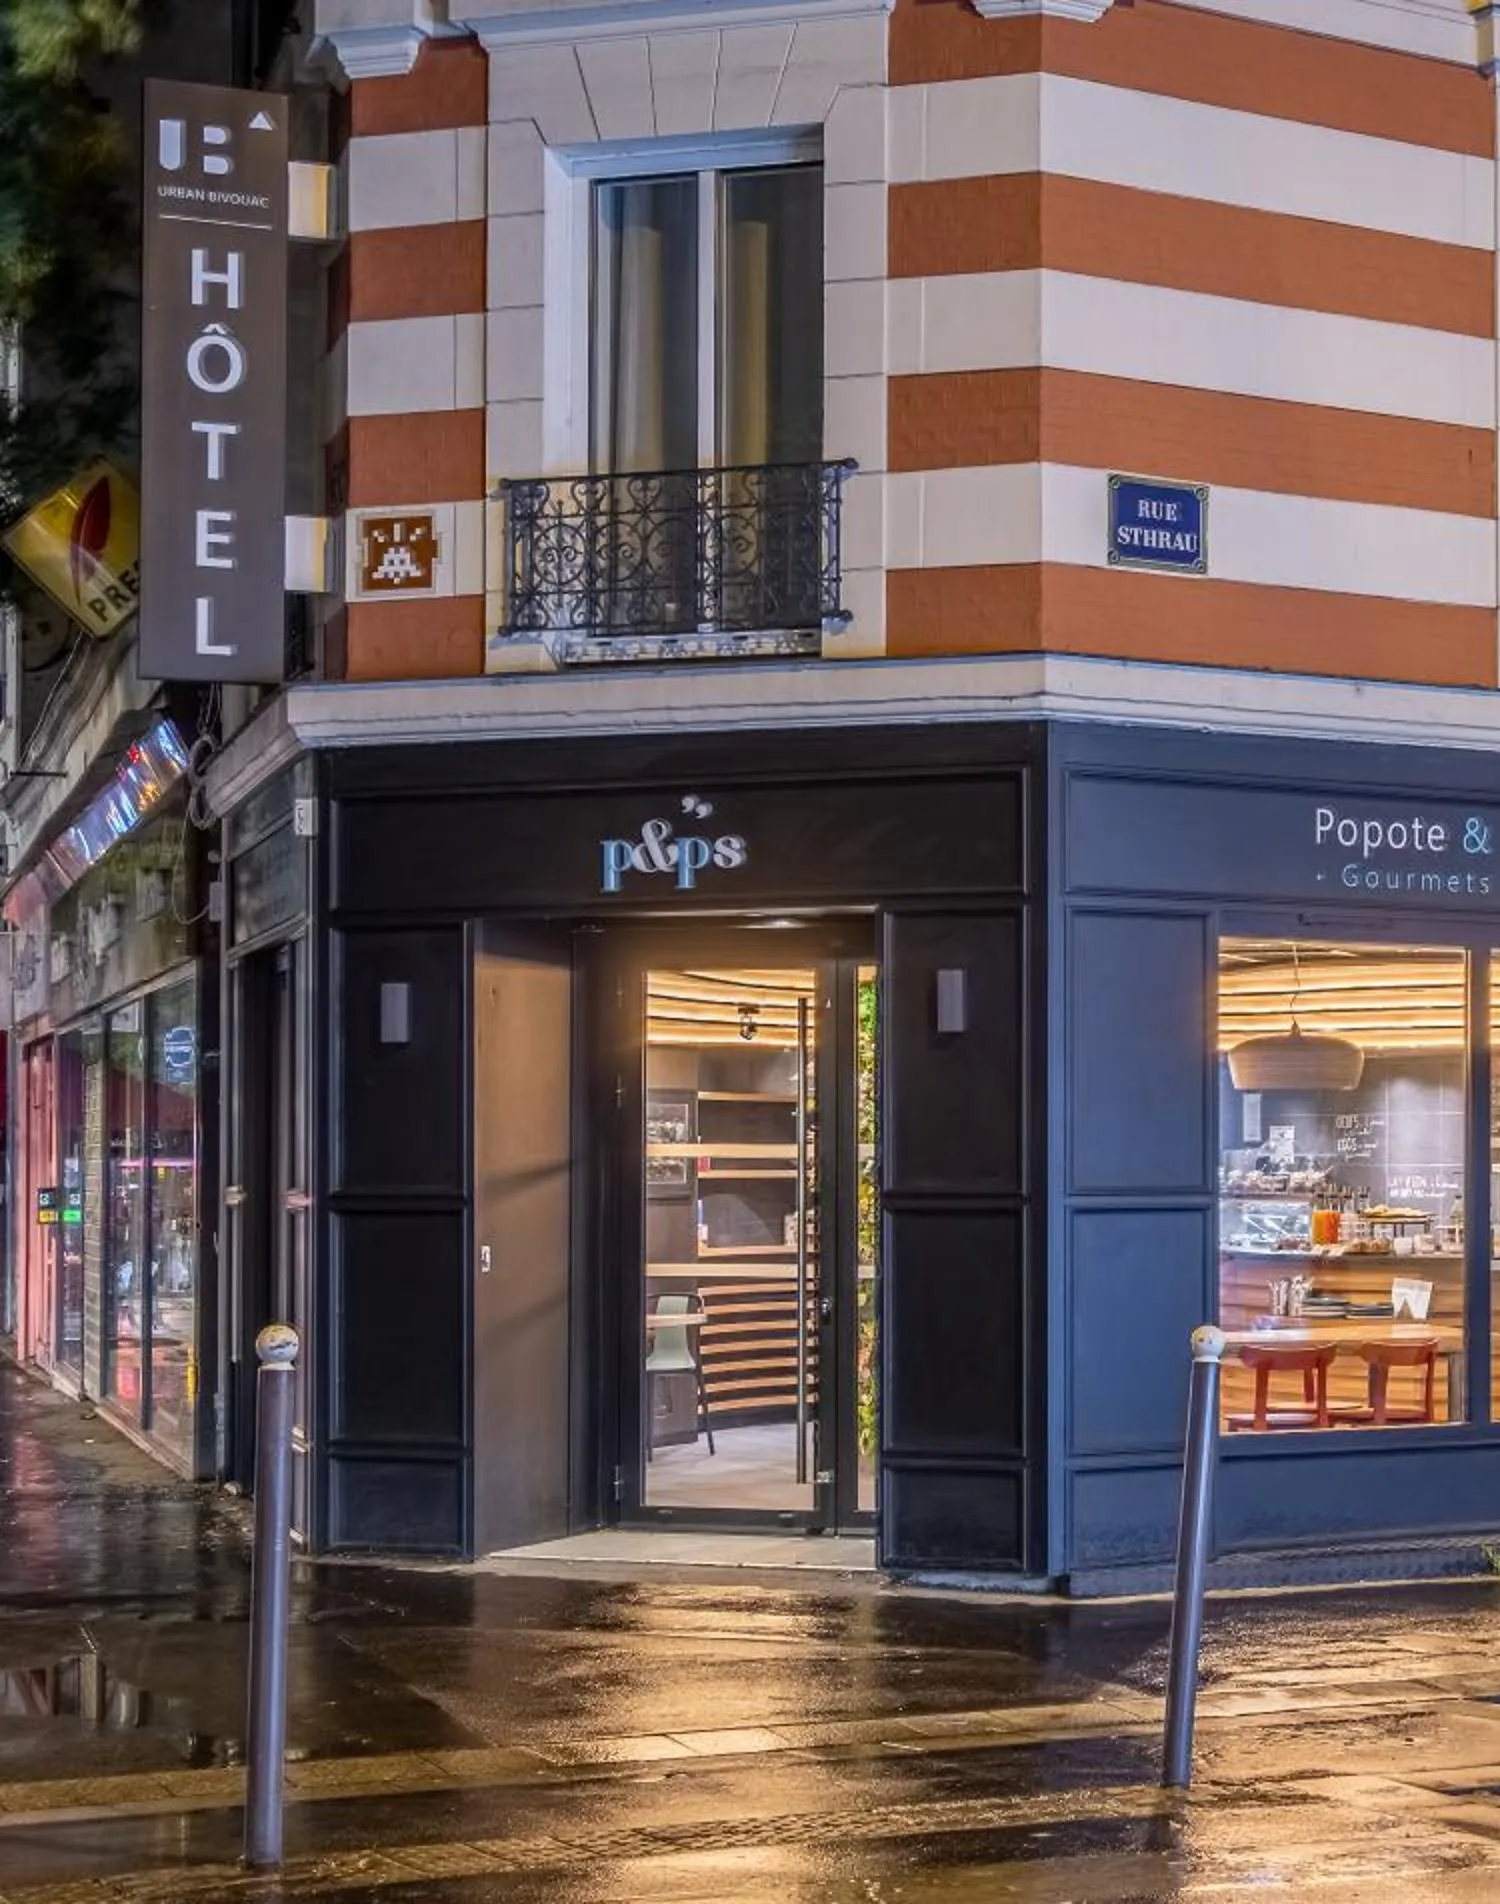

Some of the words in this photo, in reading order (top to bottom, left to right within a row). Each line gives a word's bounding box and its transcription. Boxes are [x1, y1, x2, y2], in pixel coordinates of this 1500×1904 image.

[157, 185, 205, 201] URBAN
[208, 190, 270, 209] BIVOUAC
[187, 247, 245, 657] HÔTEL
[1138, 499, 1177, 522] RUE
[1117, 525, 1198, 553] STHRAU
[87, 560, 141, 623] PRE
[1314, 808, 1446, 858] Popote
[1462, 817, 1491, 854] &
[1341, 864, 1491, 894] Gourmets
